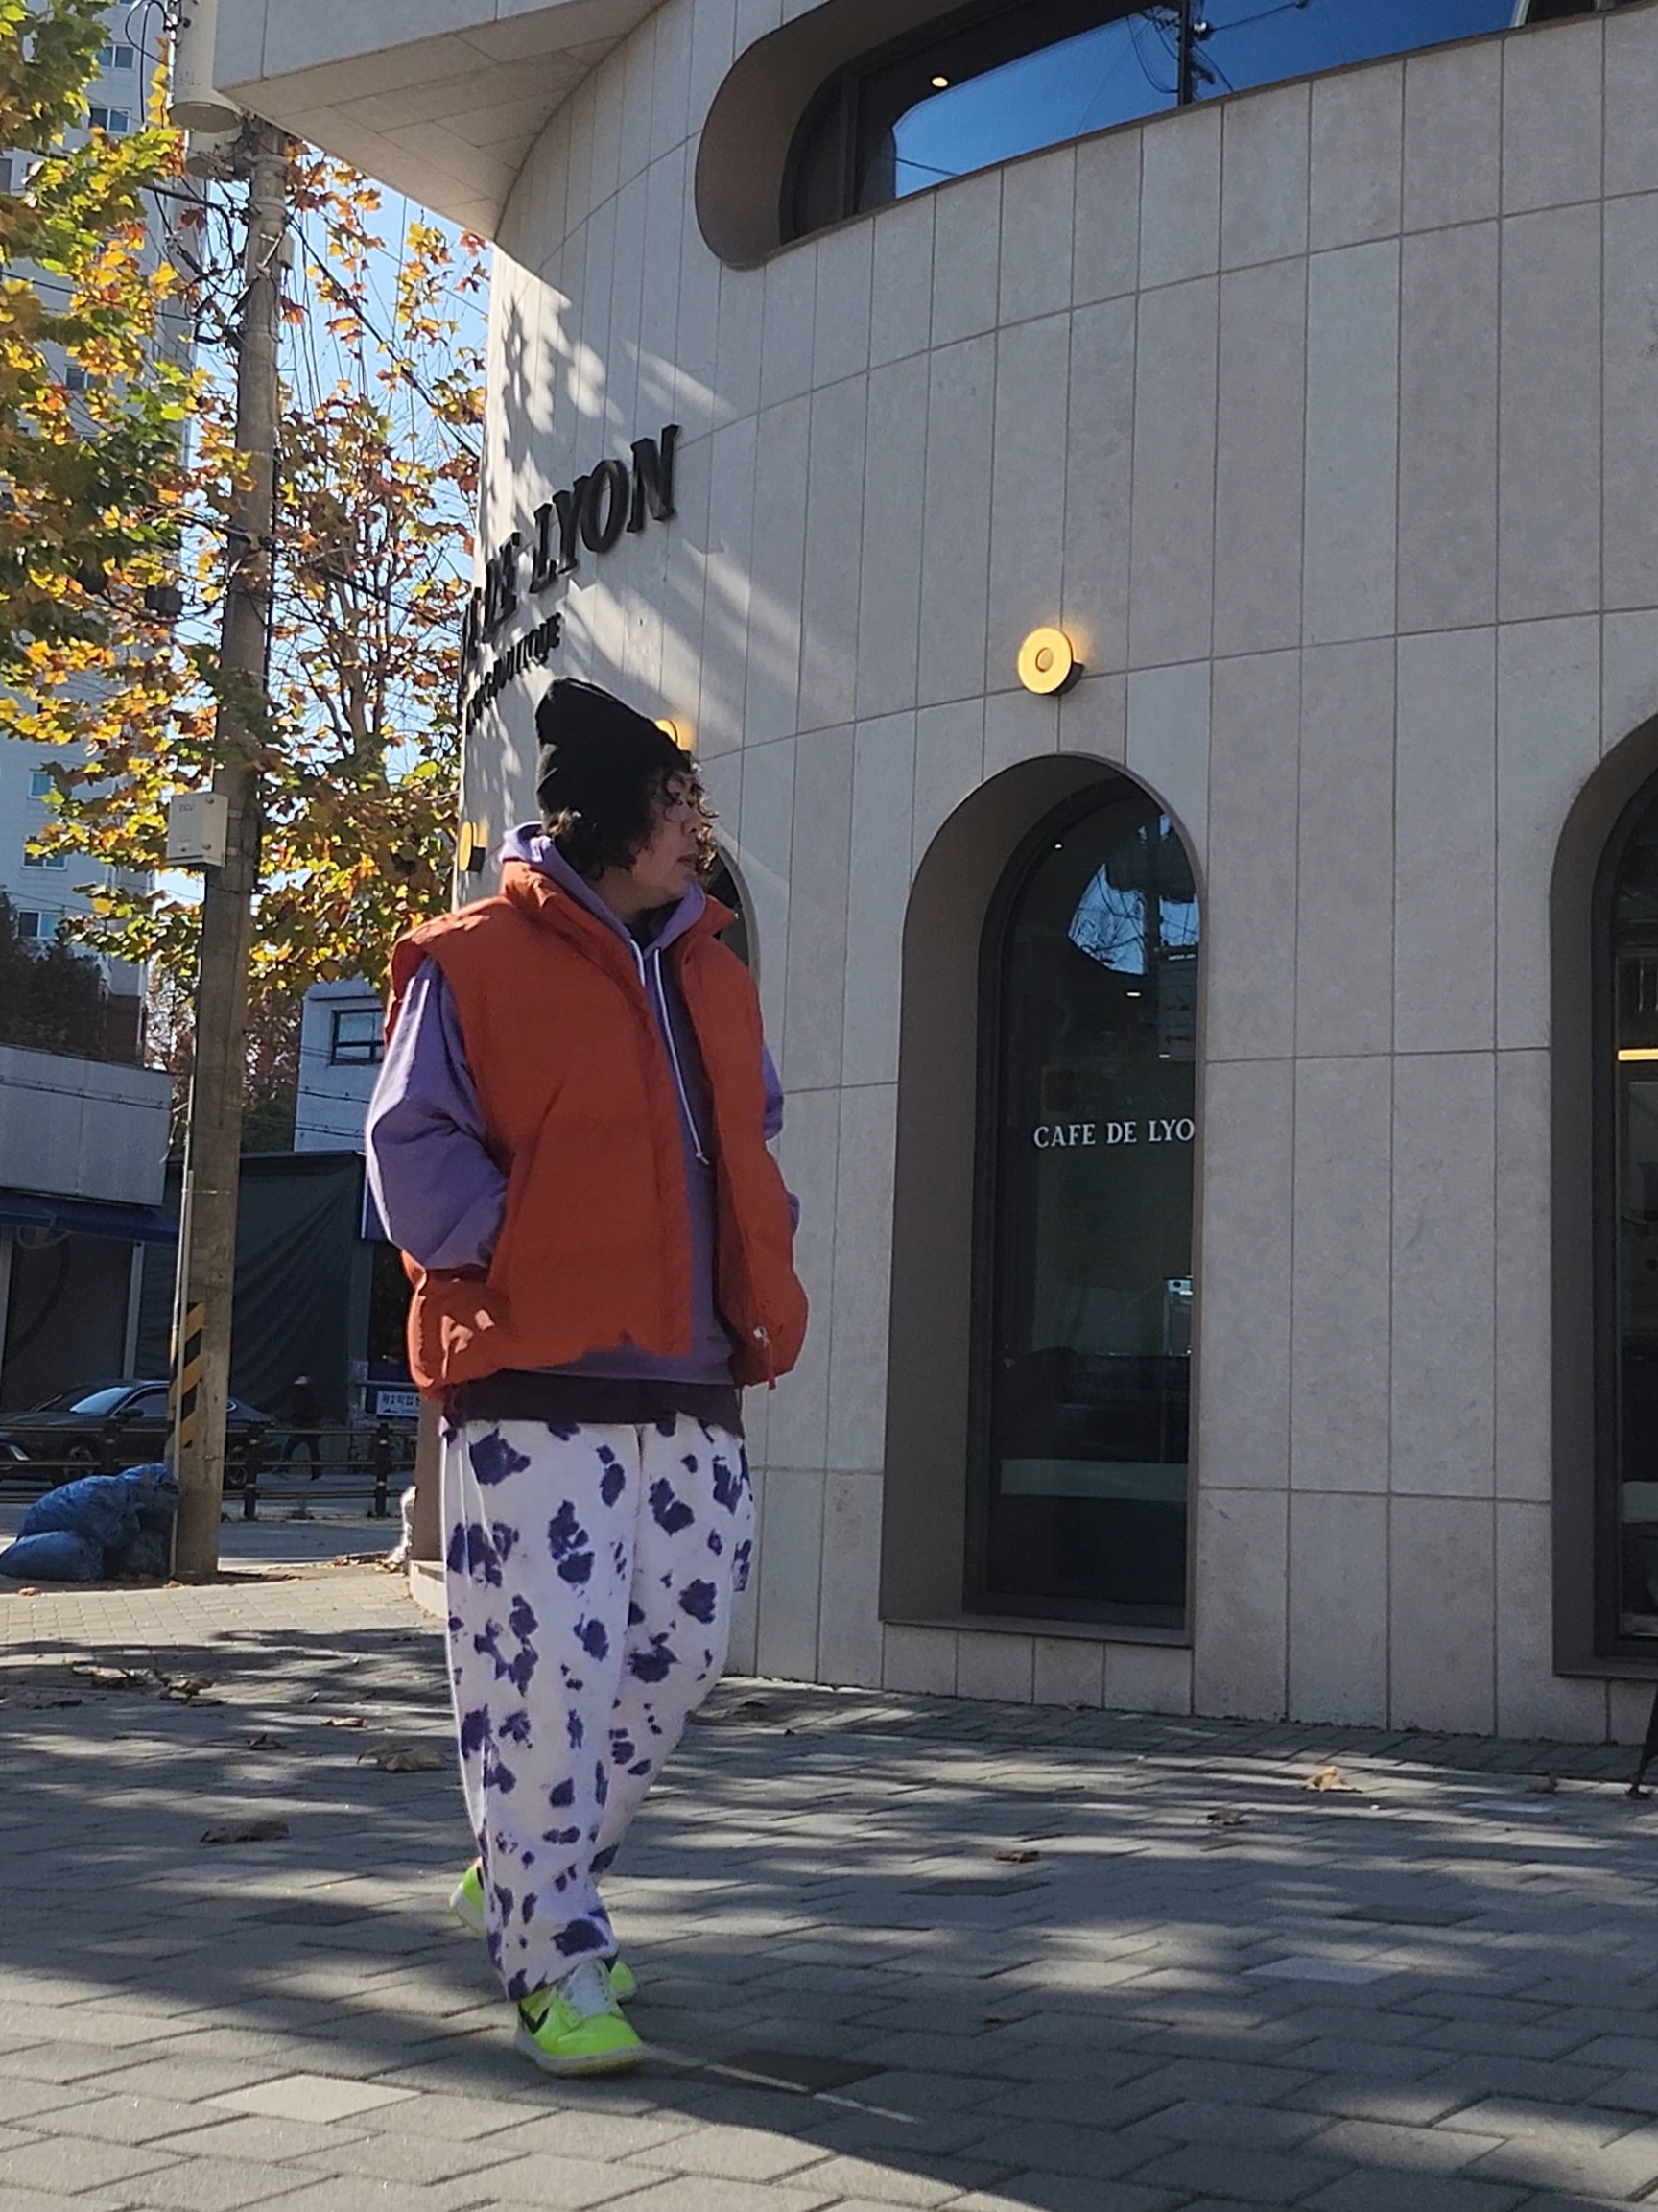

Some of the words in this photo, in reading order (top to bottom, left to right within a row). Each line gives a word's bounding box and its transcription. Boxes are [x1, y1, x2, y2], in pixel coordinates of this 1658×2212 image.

[529, 424, 680, 593] LYON
[1033, 1123, 1096, 1149] CAFE
[1106, 1121, 1137, 1144] DE
[1149, 1118, 1196, 1142] LYO
